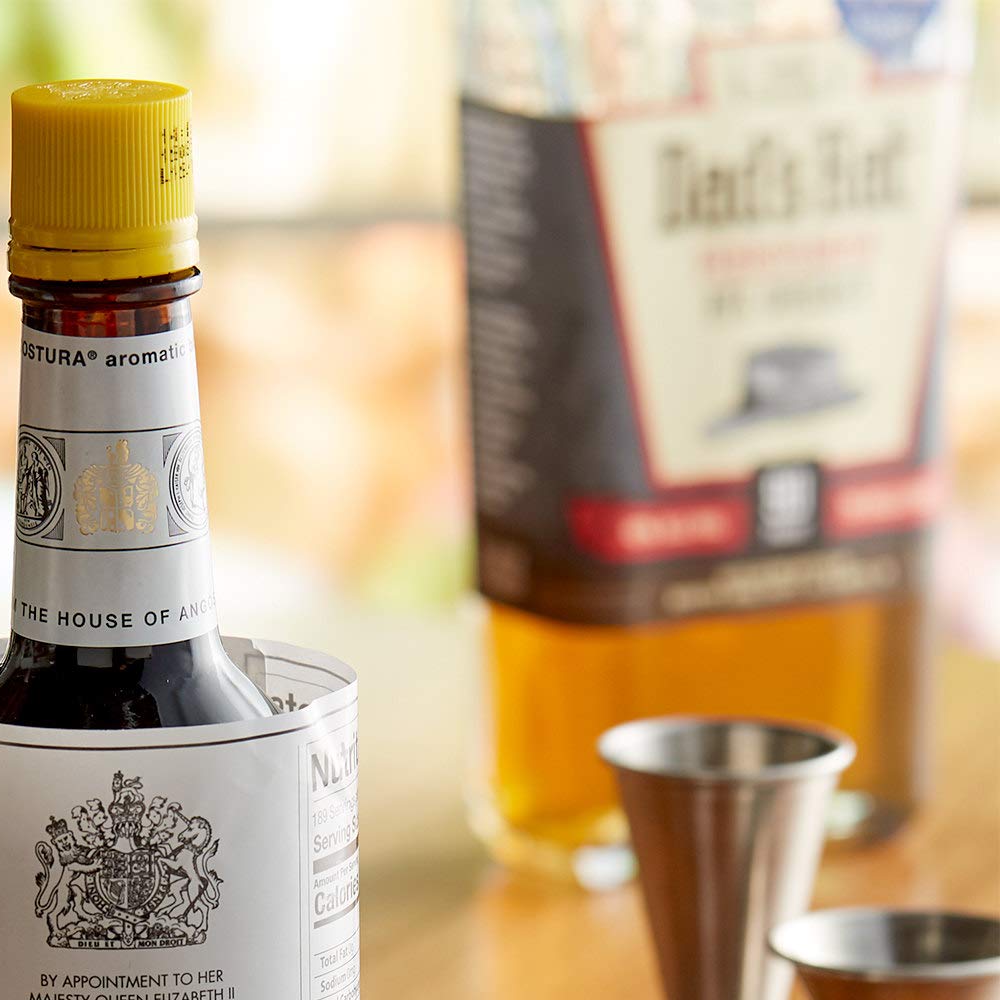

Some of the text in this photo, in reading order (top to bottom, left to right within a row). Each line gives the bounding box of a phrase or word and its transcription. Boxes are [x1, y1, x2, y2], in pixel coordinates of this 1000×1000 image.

[105, 343, 186, 367] aromatic
[21, 601, 48, 624] THE
[57, 610, 133, 629] HOUSE
[144, 609, 170, 626] OF
[40, 969, 223, 989] BY APPOINTMENT TO HER
[228, 987, 235, 999] II
